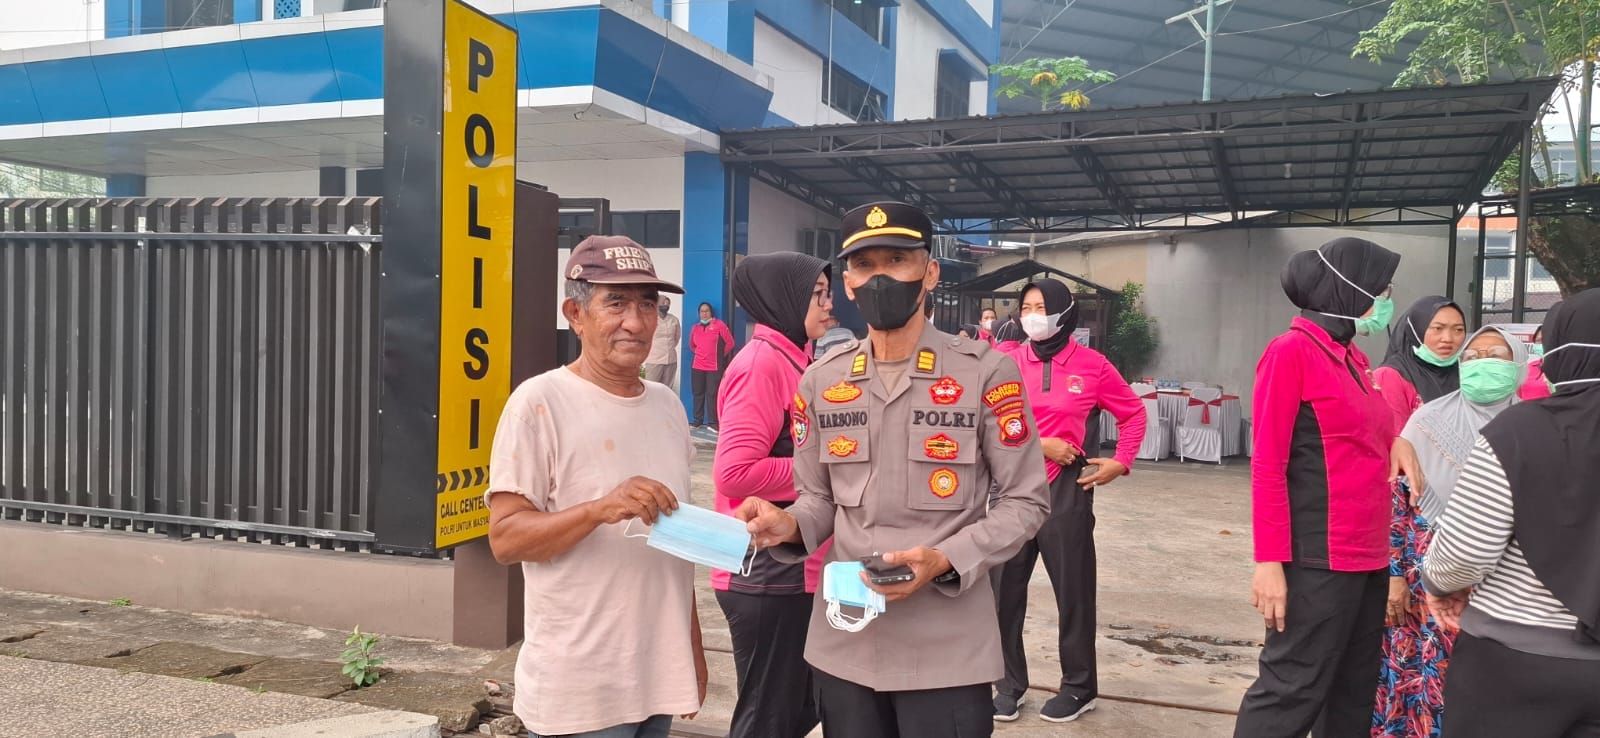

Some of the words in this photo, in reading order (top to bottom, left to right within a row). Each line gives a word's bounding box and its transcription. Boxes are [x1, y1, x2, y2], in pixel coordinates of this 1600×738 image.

[463, 37, 495, 450] POLISI
[818, 411, 868, 428] HARSONO
[912, 410, 976, 428] POLRI
[441, 500, 458, 518] CALL
